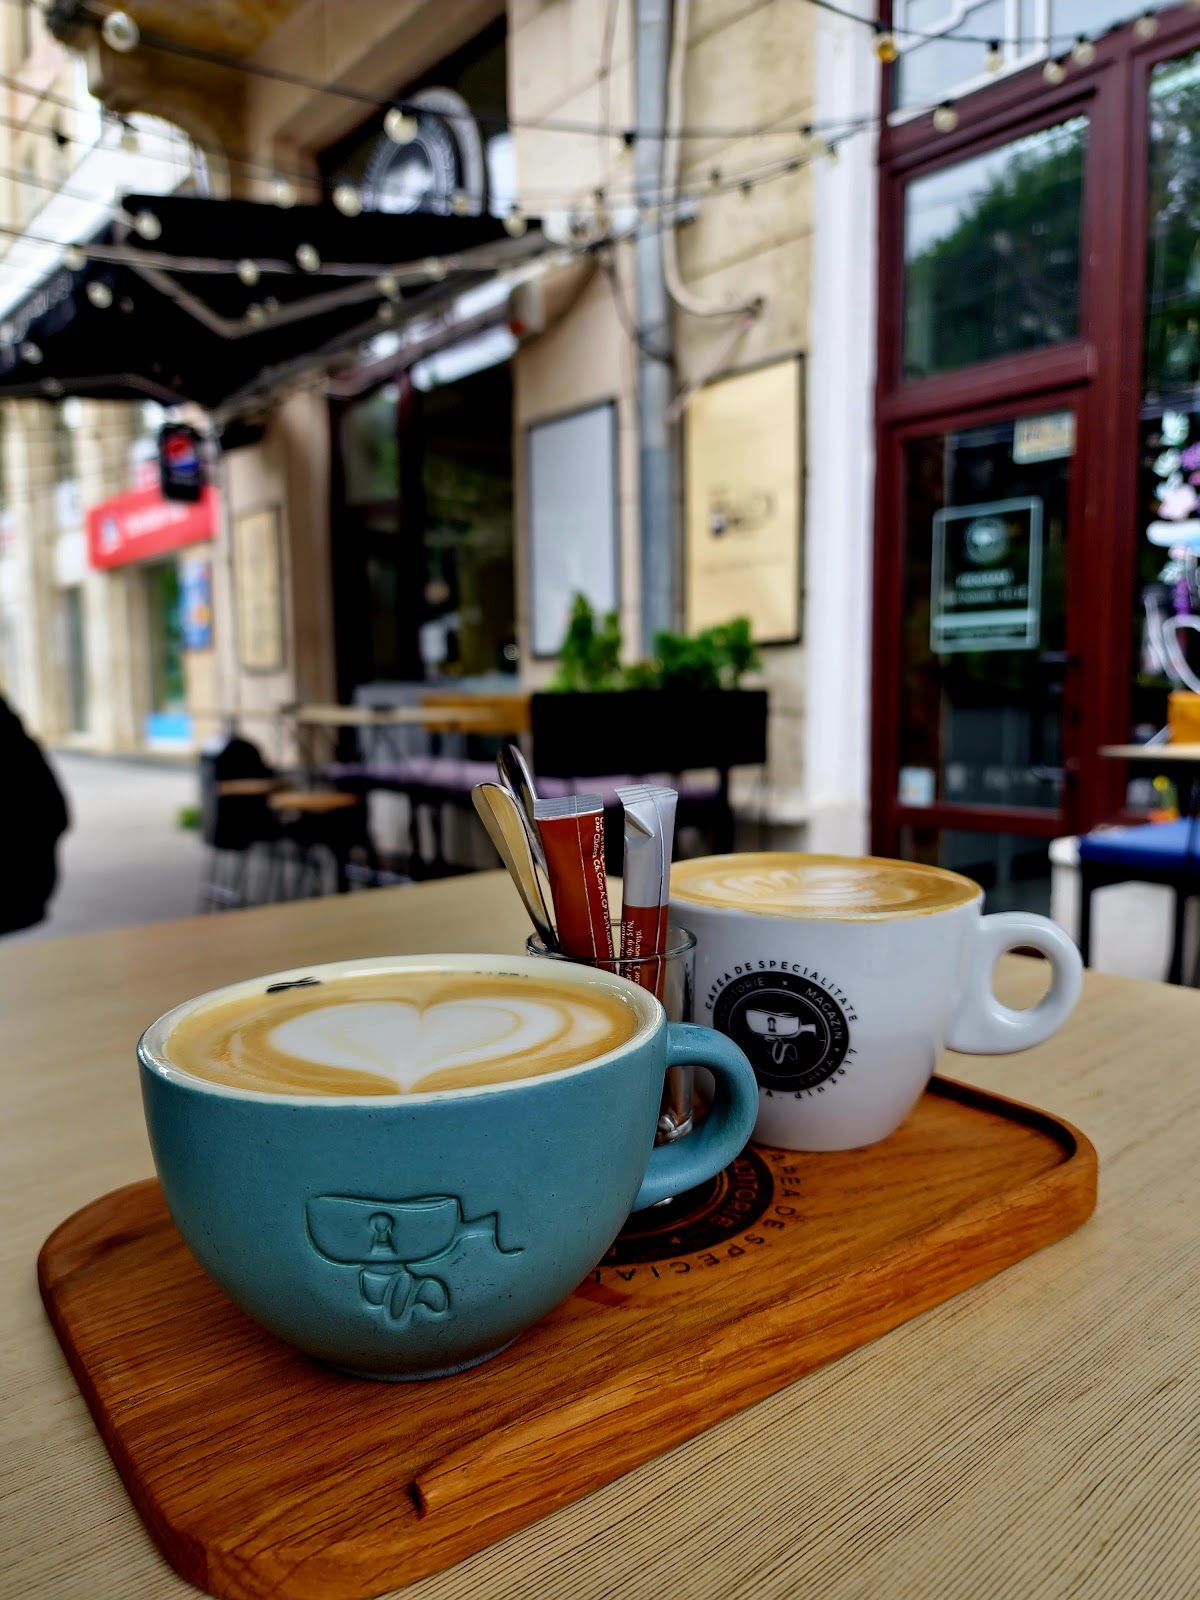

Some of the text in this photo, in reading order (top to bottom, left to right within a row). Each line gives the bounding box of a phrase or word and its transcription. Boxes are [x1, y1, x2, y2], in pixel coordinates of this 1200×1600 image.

[705, 960, 859, 1021] CAFEA DE SPECIALITATE
[805, 987, 843, 1040] MAGAZIN
[594, 1153, 801, 1283] AFEA DE SPECIAL
